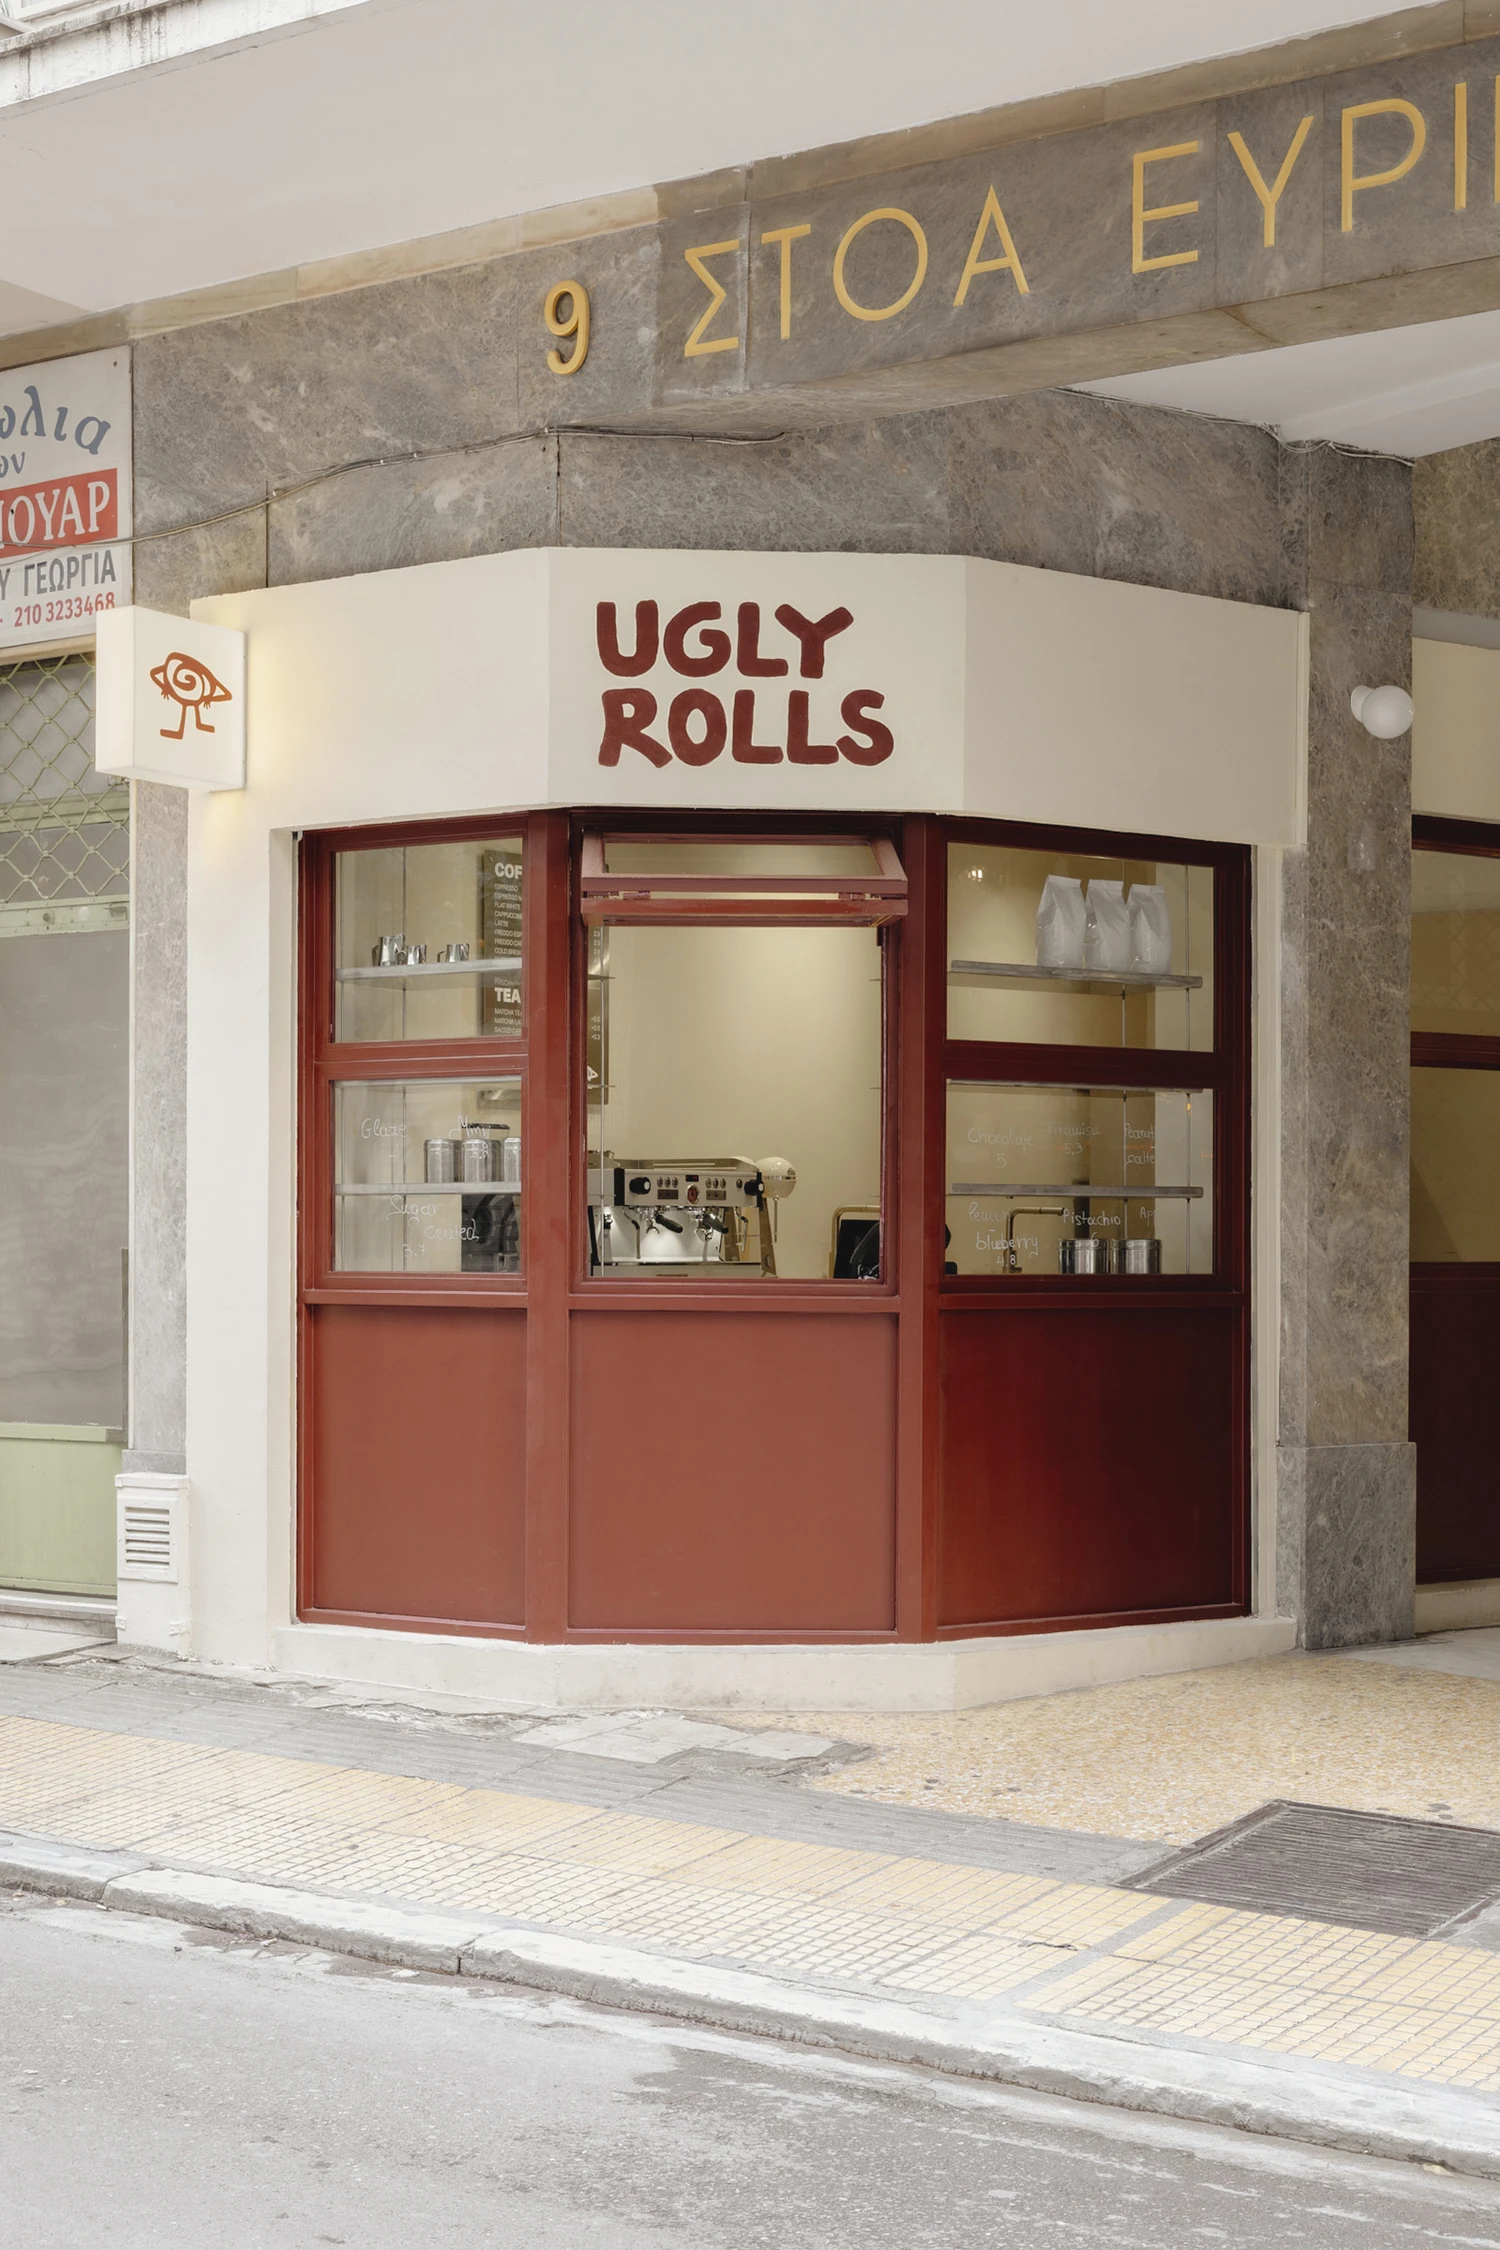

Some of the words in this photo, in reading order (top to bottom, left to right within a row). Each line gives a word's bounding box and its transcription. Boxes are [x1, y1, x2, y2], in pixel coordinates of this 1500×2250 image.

[684, 184, 1031, 357] ΣΤΟΑ
[543, 280, 590, 376] 9
[0, 481, 111, 550] ΟΥΑΡ
[24, 549, 117, 598] ΓΕΩΡΓΙΑ
[14, 603, 42, 628] 210
[45, 591, 116, 623] 3233468
[596, 599, 855, 679] UGLY
[598, 687, 895, 768] ROLLS
[494, 919, 509, 928] LATTE
[494, 928, 513, 937] FREDDO
[494, 938, 513, 946] FREDDO
[494, 947, 508, 955] COLD
[494, 986, 522, 1004] TEA
[494, 1008, 514, 1016] MATCHA
[494, 1017, 514, 1025] MATCHA
[361, 1117, 409, 1140] Glaze
[386, 1195, 440, 1227] Sugar
